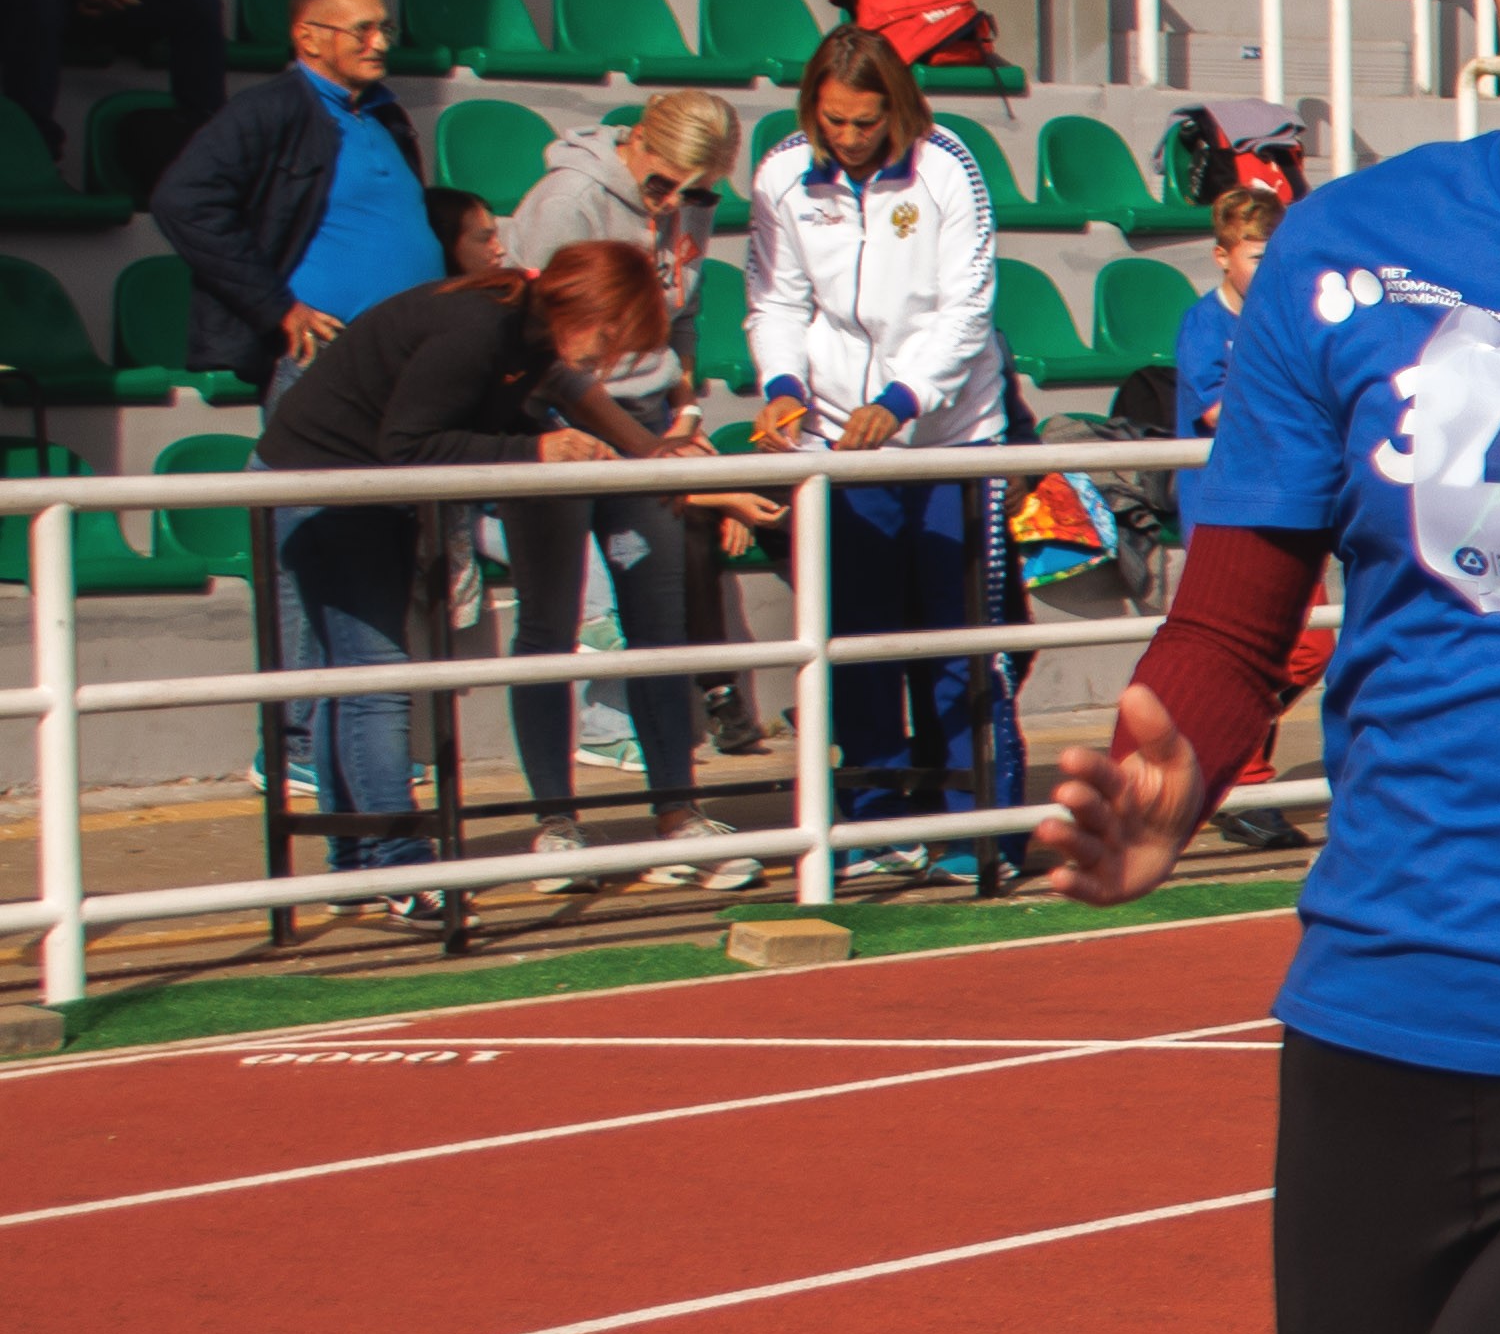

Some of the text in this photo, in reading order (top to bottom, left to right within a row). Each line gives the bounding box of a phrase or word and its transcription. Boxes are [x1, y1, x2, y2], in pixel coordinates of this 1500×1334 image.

[1381, 267, 1411, 279] ЛЕТ
[1385, 281, 1463, 300] АТОМНОЙ
[241, 1049, 512, 1065] 10000
